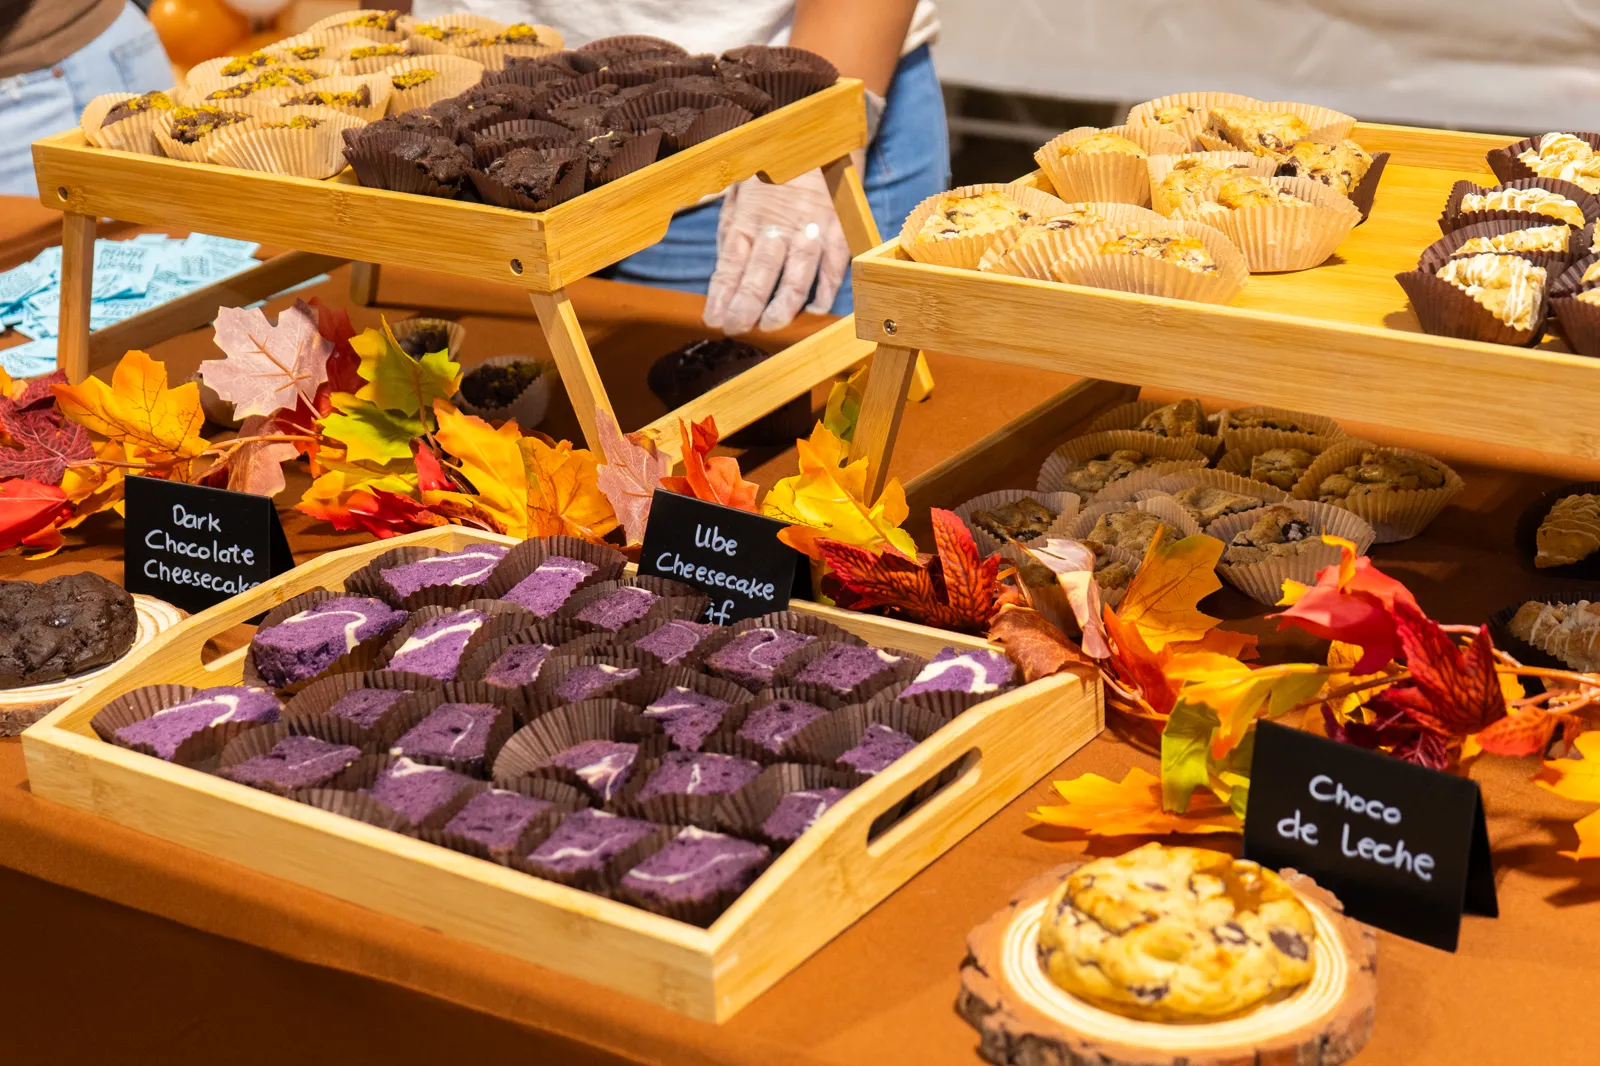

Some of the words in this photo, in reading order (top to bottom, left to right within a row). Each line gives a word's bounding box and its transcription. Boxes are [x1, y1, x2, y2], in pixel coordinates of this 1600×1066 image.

[172, 504, 222, 533] Dark
[695, 524, 738, 556] Ube
[144, 529, 255, 566] Chocolate
[656, 552, 775, 601] Cheesecake
[1308, 774, 1402, 824] Choco
[1277, 809, 1318, 846] de
[1341, 823, 1435, 881] Leche
